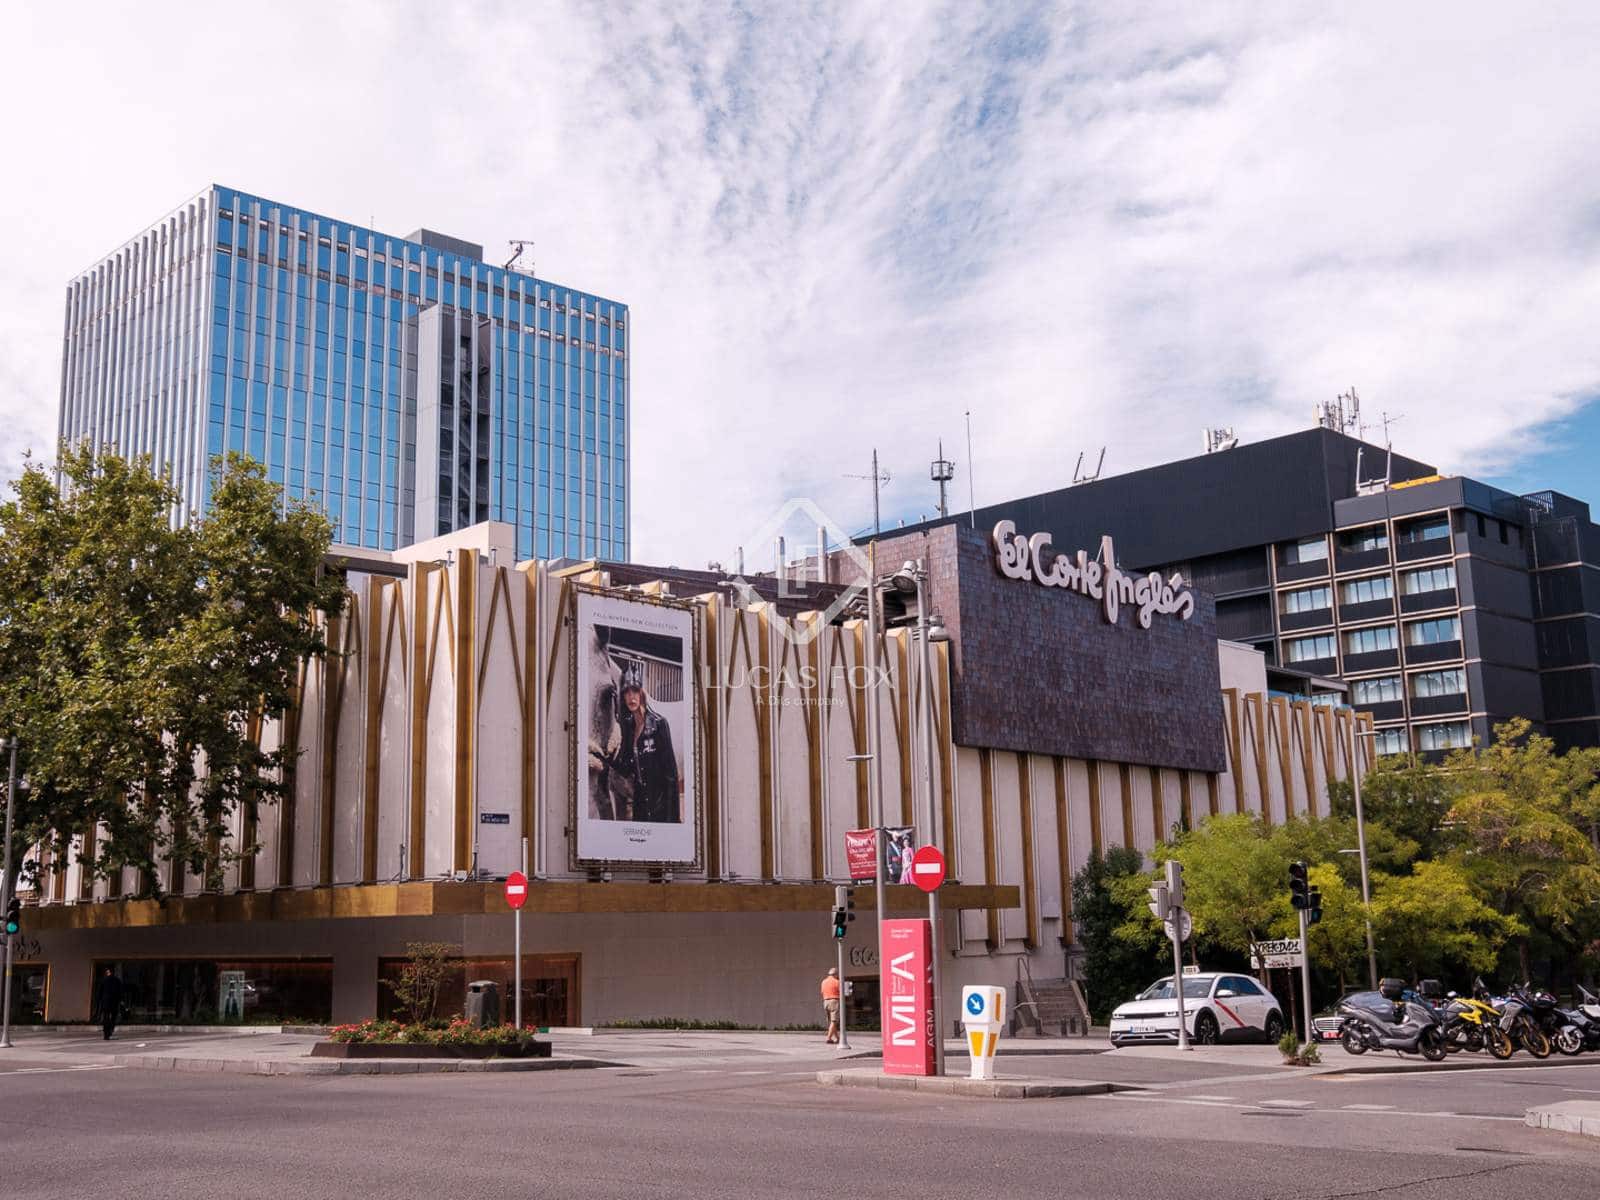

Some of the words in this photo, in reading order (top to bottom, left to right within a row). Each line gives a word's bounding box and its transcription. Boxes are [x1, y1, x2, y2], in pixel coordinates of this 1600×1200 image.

[993, 520, 1032, 581] El
[1029, 532, 1103, 600] Corte
[1101, 535, 1194, 630] Inglés
[644, 621, 679, 631] COLLECTION
